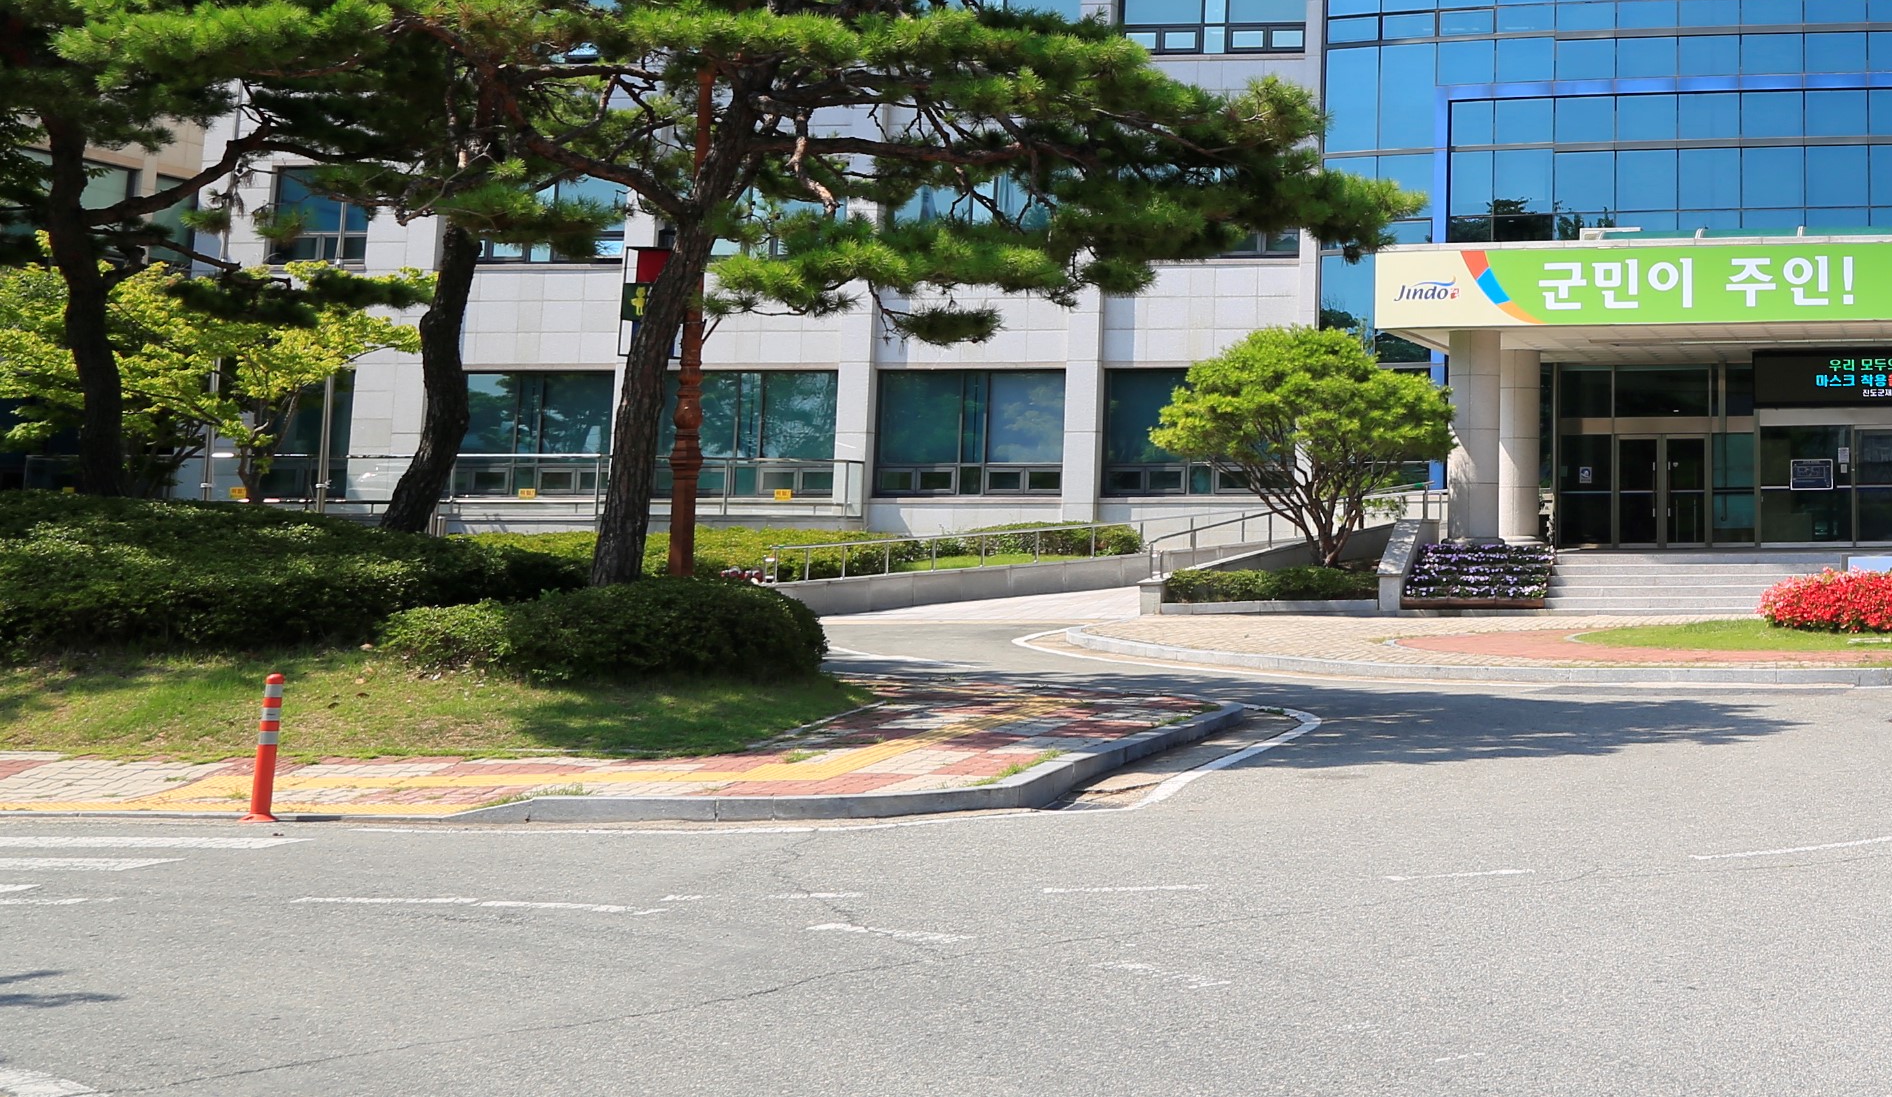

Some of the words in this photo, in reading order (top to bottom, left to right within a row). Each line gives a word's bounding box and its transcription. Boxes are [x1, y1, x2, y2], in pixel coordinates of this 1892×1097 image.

[1537, 257, 1695, 311] 군민이
[1725, 255, 1855, 308] 주인!
[1393, 285, 1449, 301] Jindo
[1829, 358, 1855, 371] 우리
[1815, 374, 1856, 387] 마스크
